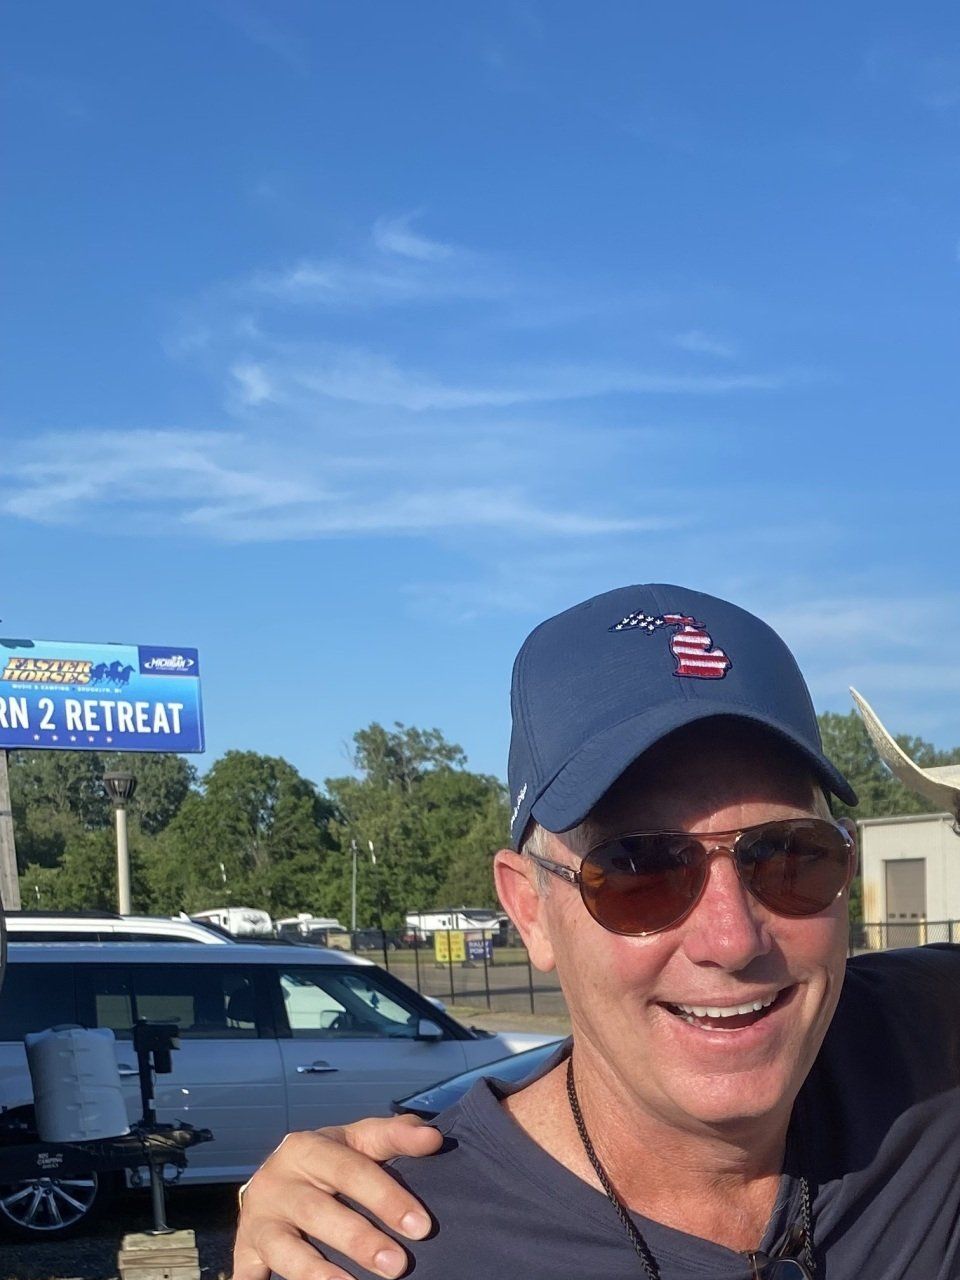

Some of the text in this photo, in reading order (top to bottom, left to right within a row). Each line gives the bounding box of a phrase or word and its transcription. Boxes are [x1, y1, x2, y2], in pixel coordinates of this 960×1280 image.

[8, 657, 93, 672] FASTER
[2, 669, 92, 684] HORSES
[38, 697, 56, 730] 2
[65, 699, 184, 734] RETREAT
